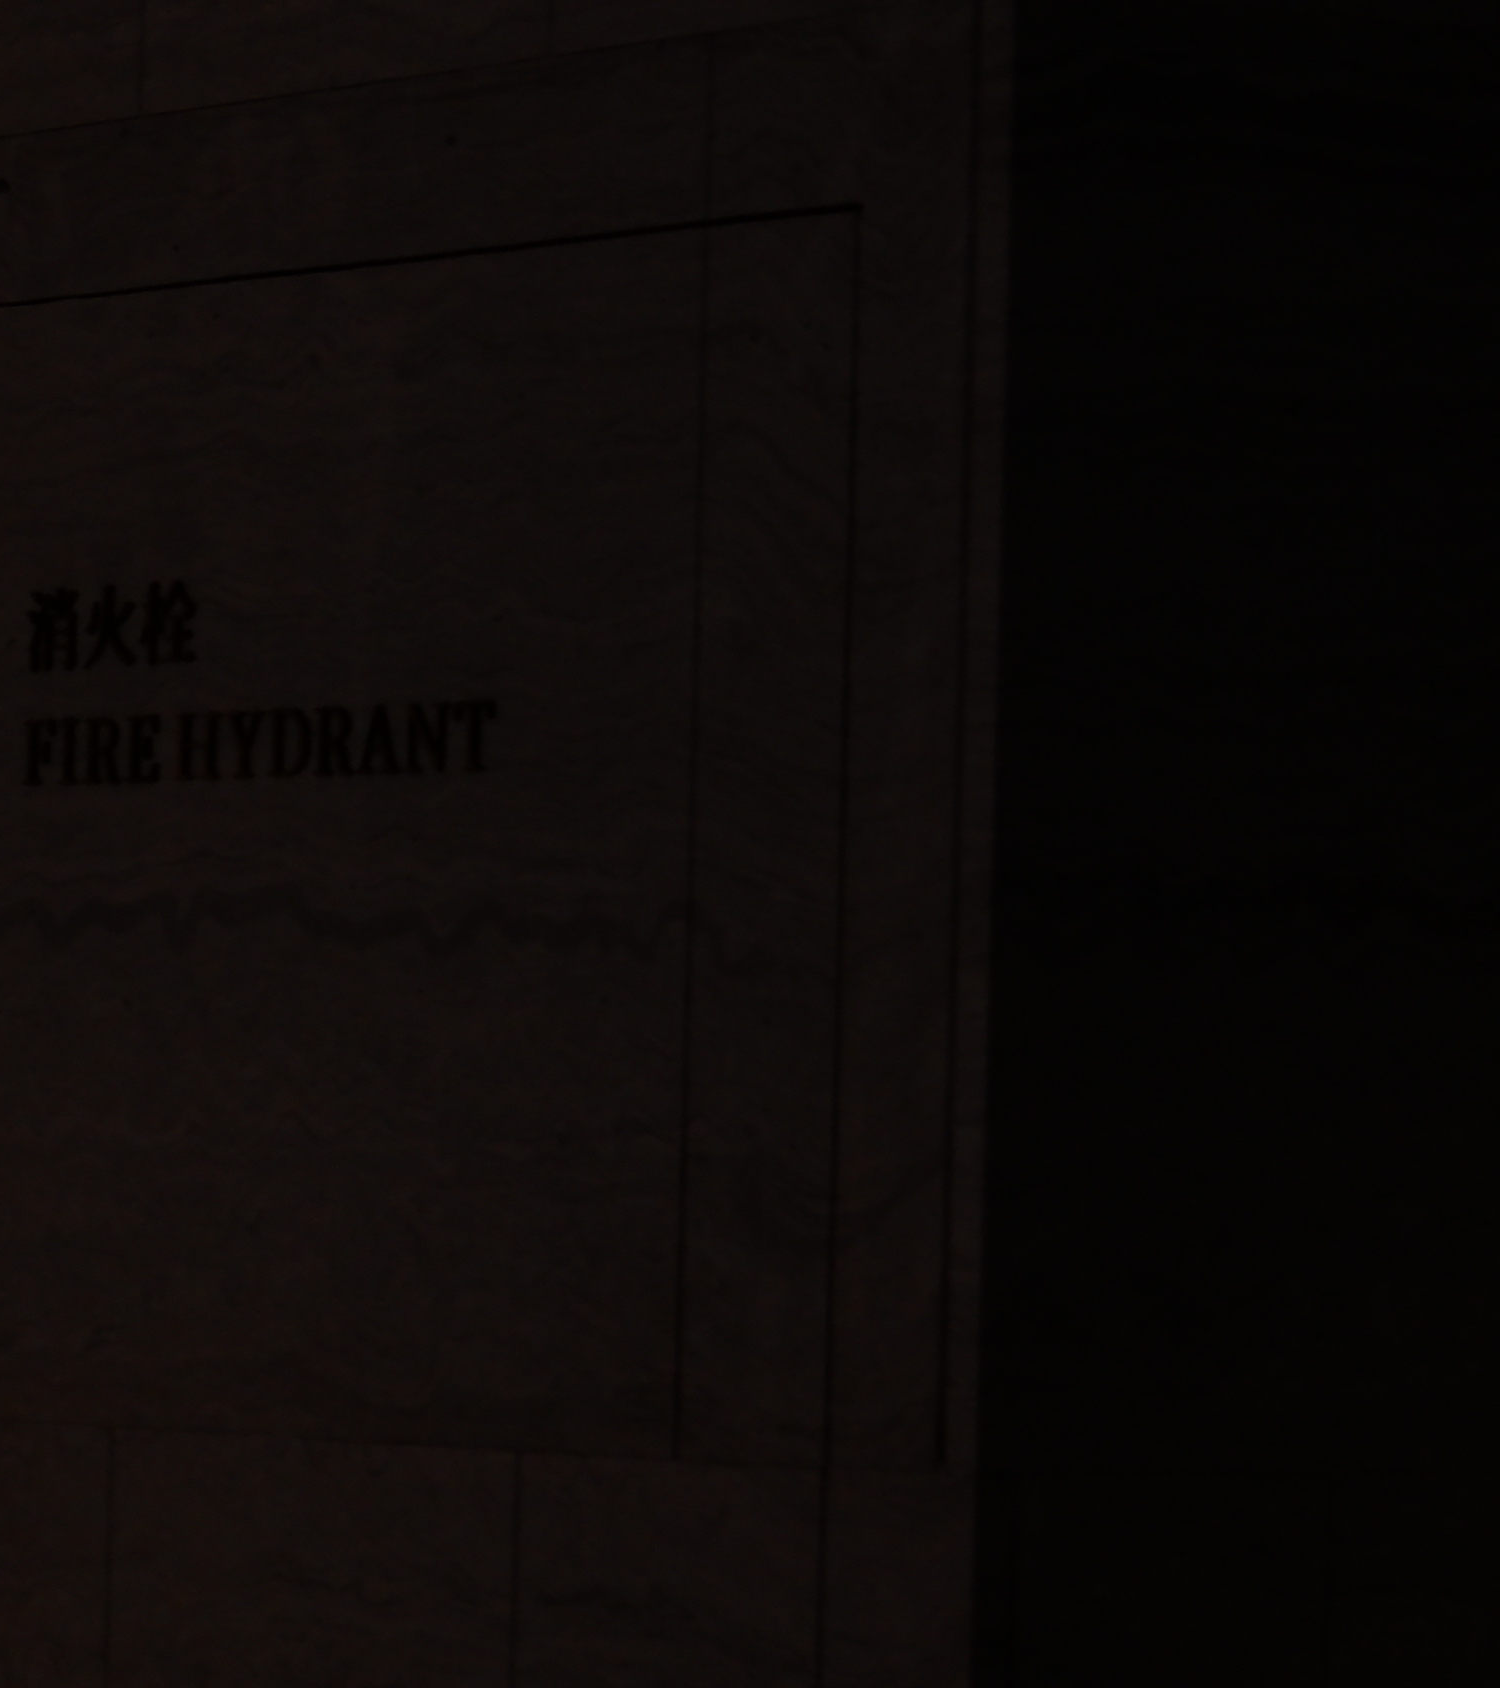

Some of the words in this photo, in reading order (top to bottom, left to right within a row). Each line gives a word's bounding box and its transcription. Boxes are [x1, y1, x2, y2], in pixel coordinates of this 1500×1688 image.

[28, 580, 197, 672] 消火栓
[24, 713, 160, 785] FIRE
[174, 700, 497, 780] HYDRANT
